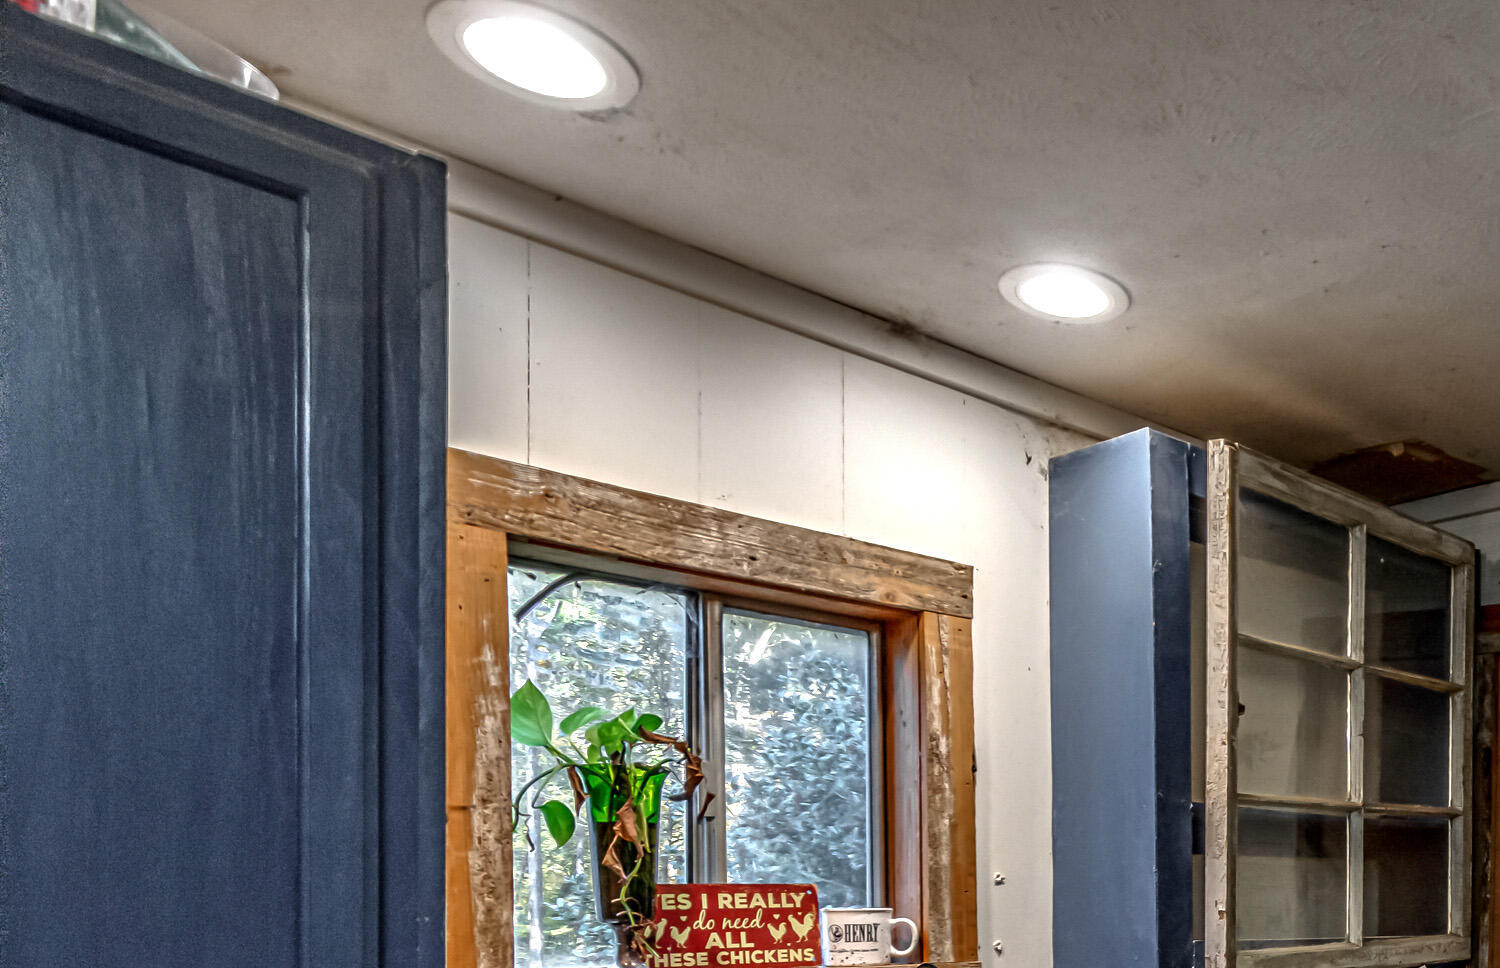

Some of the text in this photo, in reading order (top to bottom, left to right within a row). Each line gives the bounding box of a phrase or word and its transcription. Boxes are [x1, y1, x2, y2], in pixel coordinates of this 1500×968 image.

[656, 892, 806, 910] ES I REALLY
[693, 908, 765, 930] do need
[705, 931, 755, 949] ALL
[844, 923, 880, 942] HENRY
[716, 948, 814, 966] CHICKENS
